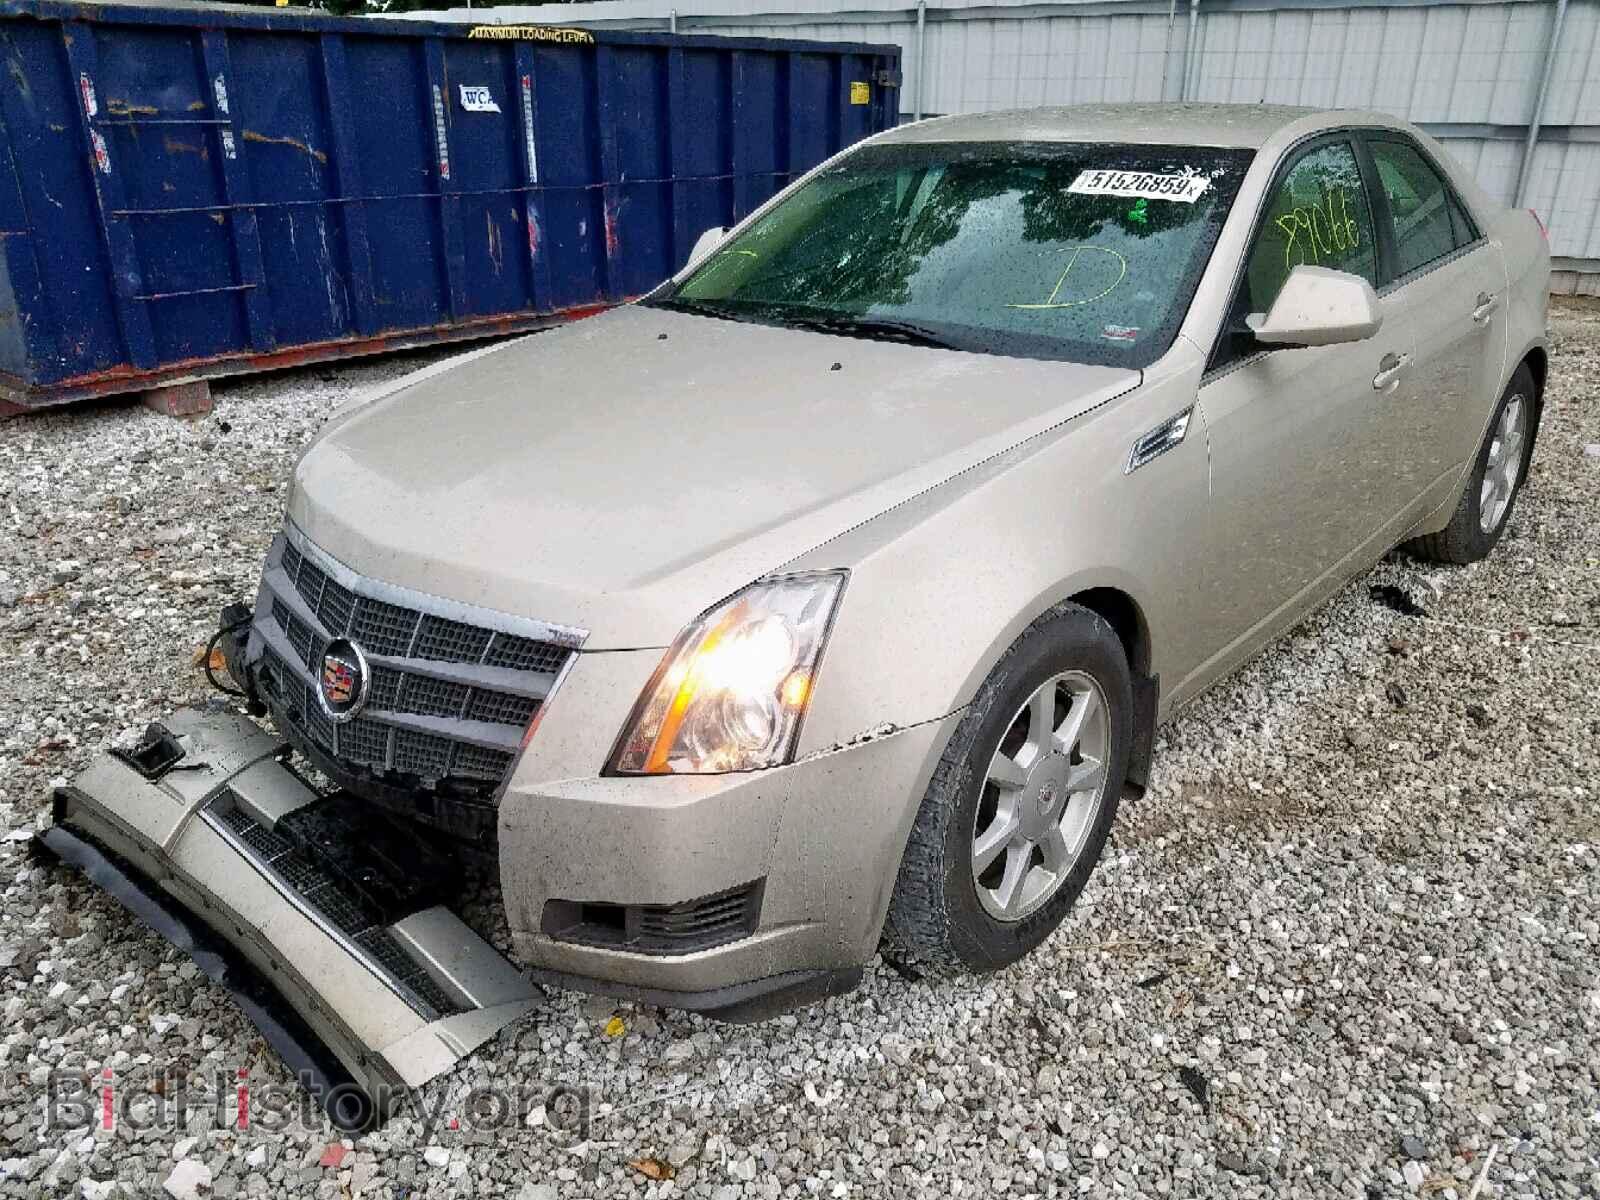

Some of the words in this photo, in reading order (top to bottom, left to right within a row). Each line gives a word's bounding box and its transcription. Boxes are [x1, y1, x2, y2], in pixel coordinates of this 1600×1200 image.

[475, 27, 520, 40] MAXIMUM
[522, 28, 561, 42] LOADING
[1086, 171, 1191, 195] 51526859
